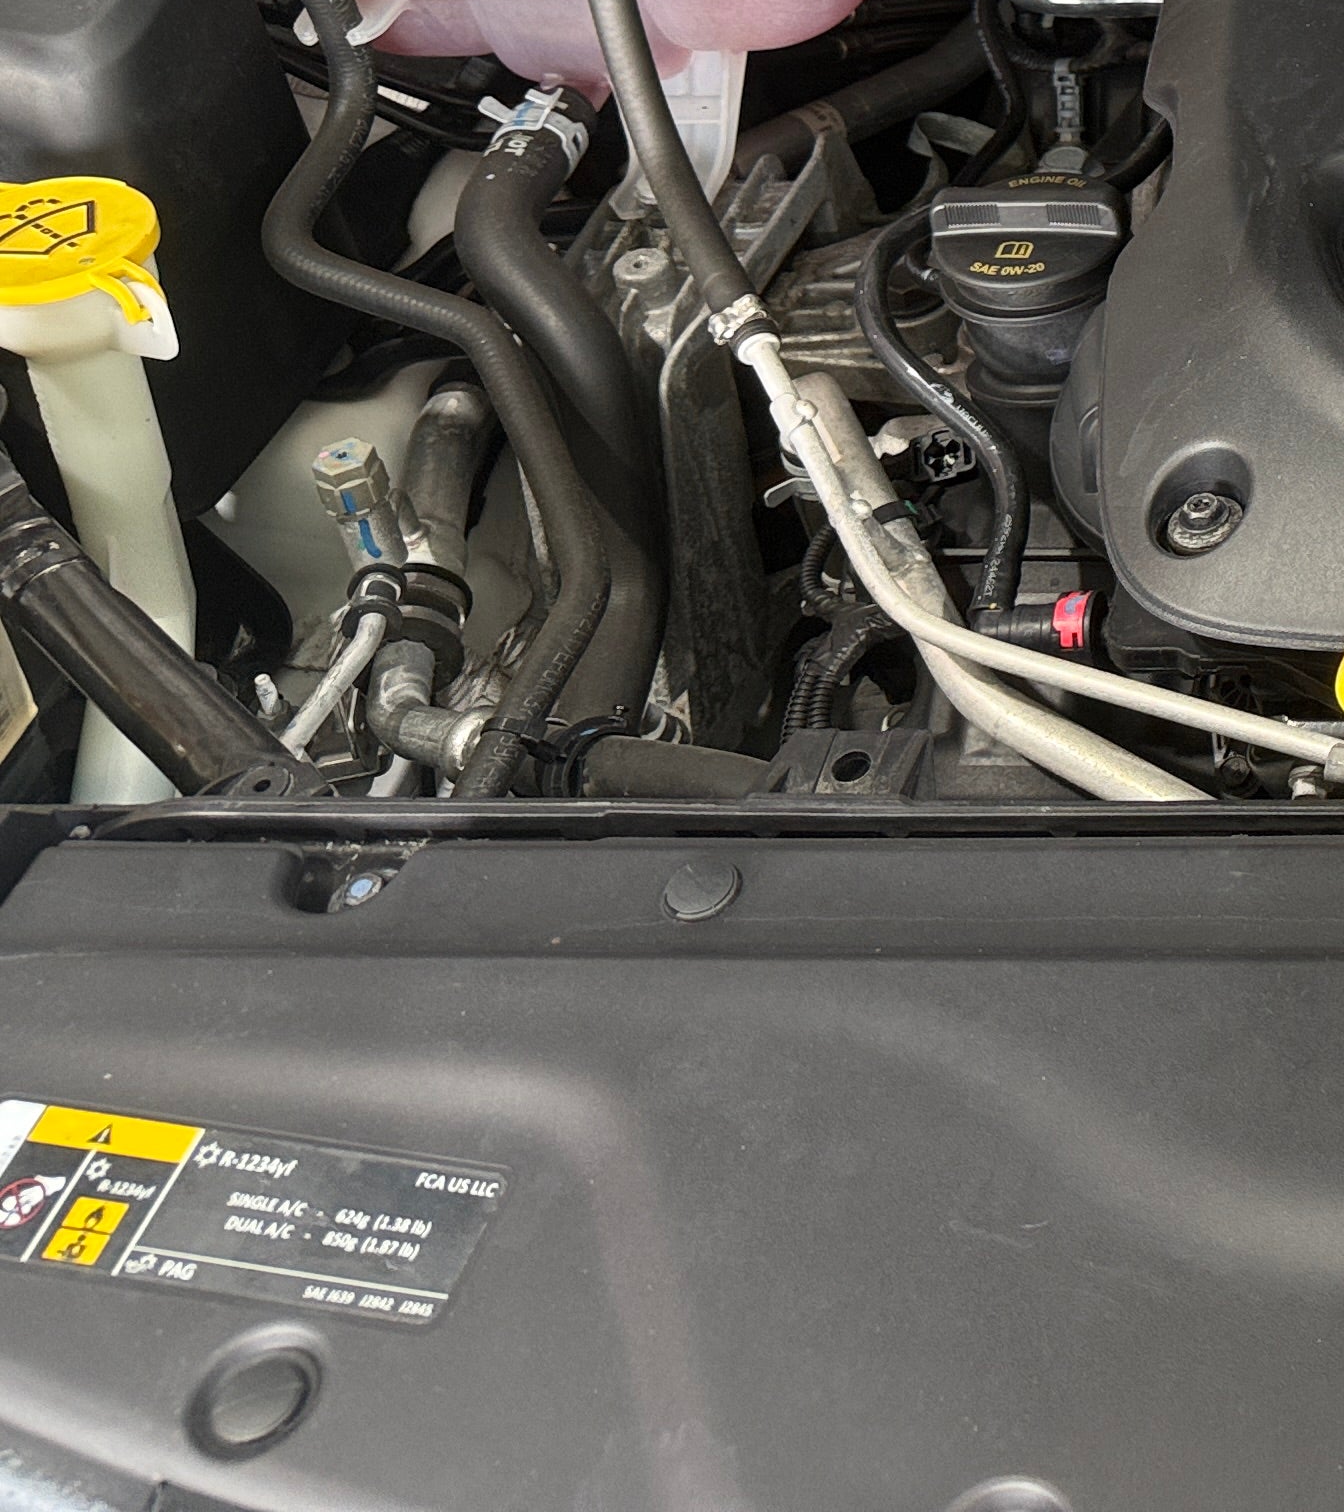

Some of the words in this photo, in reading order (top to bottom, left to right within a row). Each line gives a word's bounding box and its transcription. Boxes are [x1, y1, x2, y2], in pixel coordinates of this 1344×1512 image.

[1008, 175, 1064, 188] ENGINE
[1067, 178, 1087, 188] OIL
[970, 262, 997, 275] SAE
[1000, 262, 1045, 276] 0W-20
[218, 1150, 298, 1179] R-1234yf
[415, 1172, 446, 1190] FCA
[447, 1177, 471, 1194] US
[470, 1180, 500, 1198] LLC
[226, 1192, 279, 1212] SINGLE
[275, 1200, 309, 1217] A/C
[335, 1208, 371, 1230] 624g
[410, 1219, 433, 1239] lb)
[224, 1215, 265, 1235] DUAL
[263, 1222, 296, 1239] A/C
[397, 1242, 421, 1262] lb)
[157, 1260, 198, 1281] PAG
[302, 1285, 326, 1301] SAE
